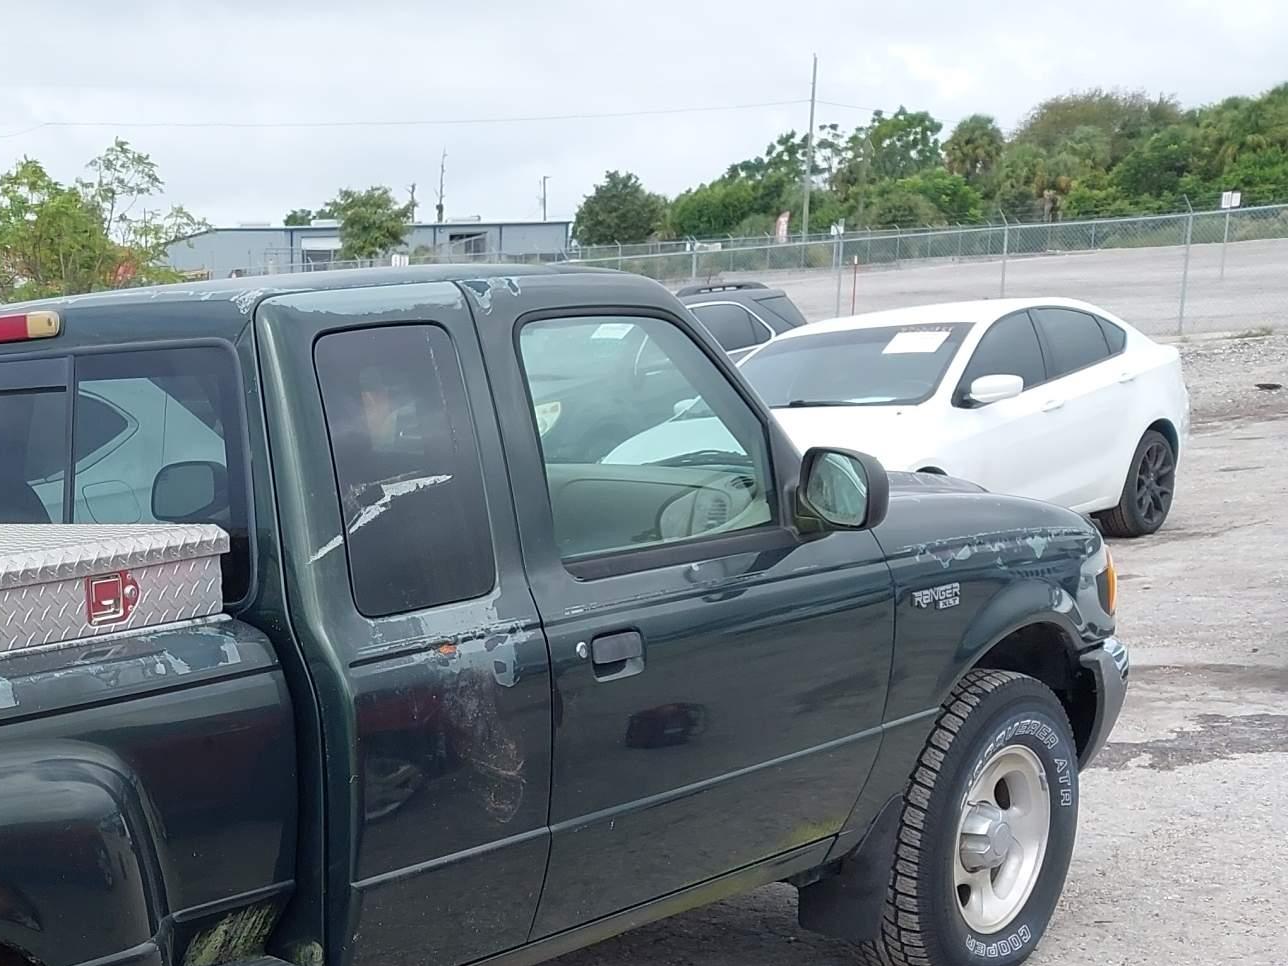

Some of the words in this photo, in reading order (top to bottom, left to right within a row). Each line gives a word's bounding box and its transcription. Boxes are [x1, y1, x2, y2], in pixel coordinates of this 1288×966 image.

[912, 582, 960, 608] RANGER
[1054, 758, 1072, 806] ATR
[965, 924, 1031, 958] COOPER
